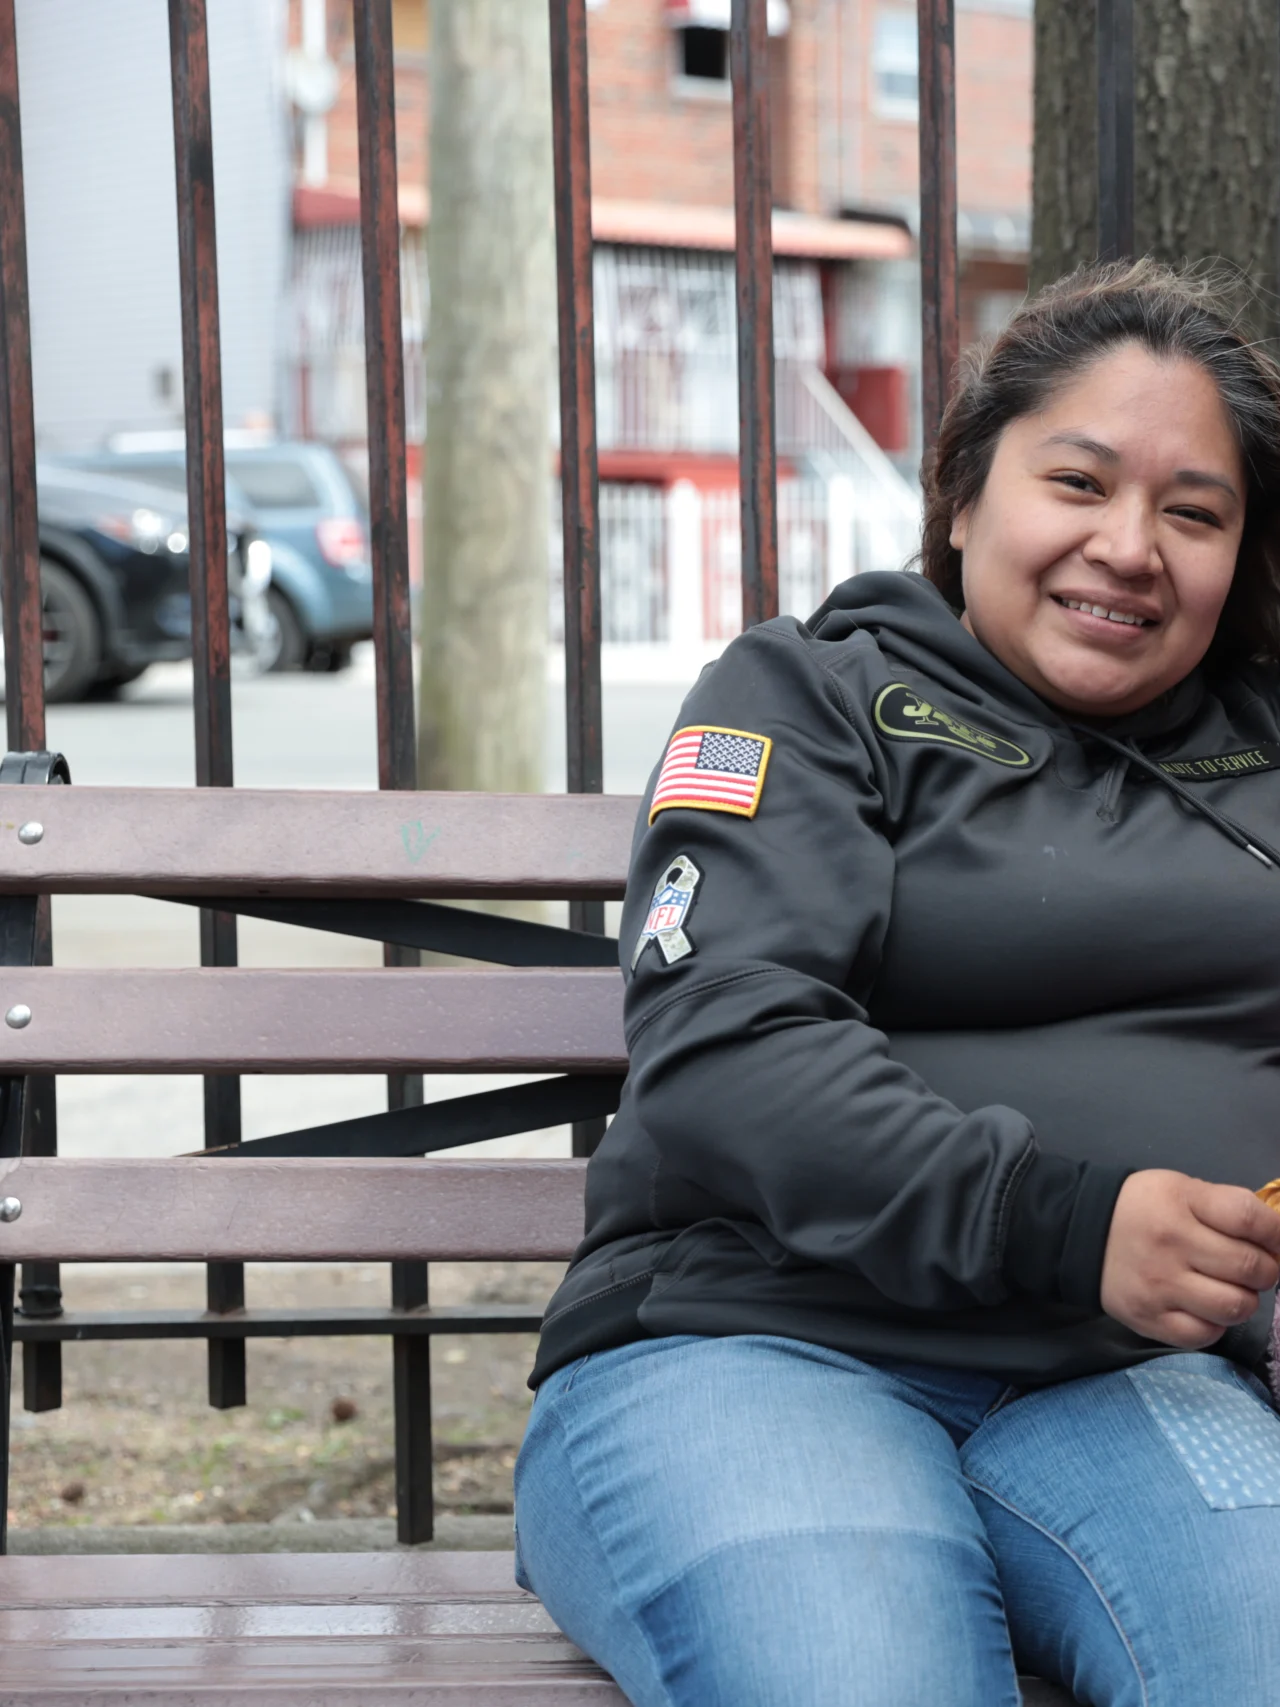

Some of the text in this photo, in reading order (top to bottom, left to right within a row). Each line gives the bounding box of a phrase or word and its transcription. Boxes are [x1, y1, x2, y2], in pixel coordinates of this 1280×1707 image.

[1158, 750, 1270, 775] ALUTE TO SERVICE
[645, 906, 677, 931] NFL
